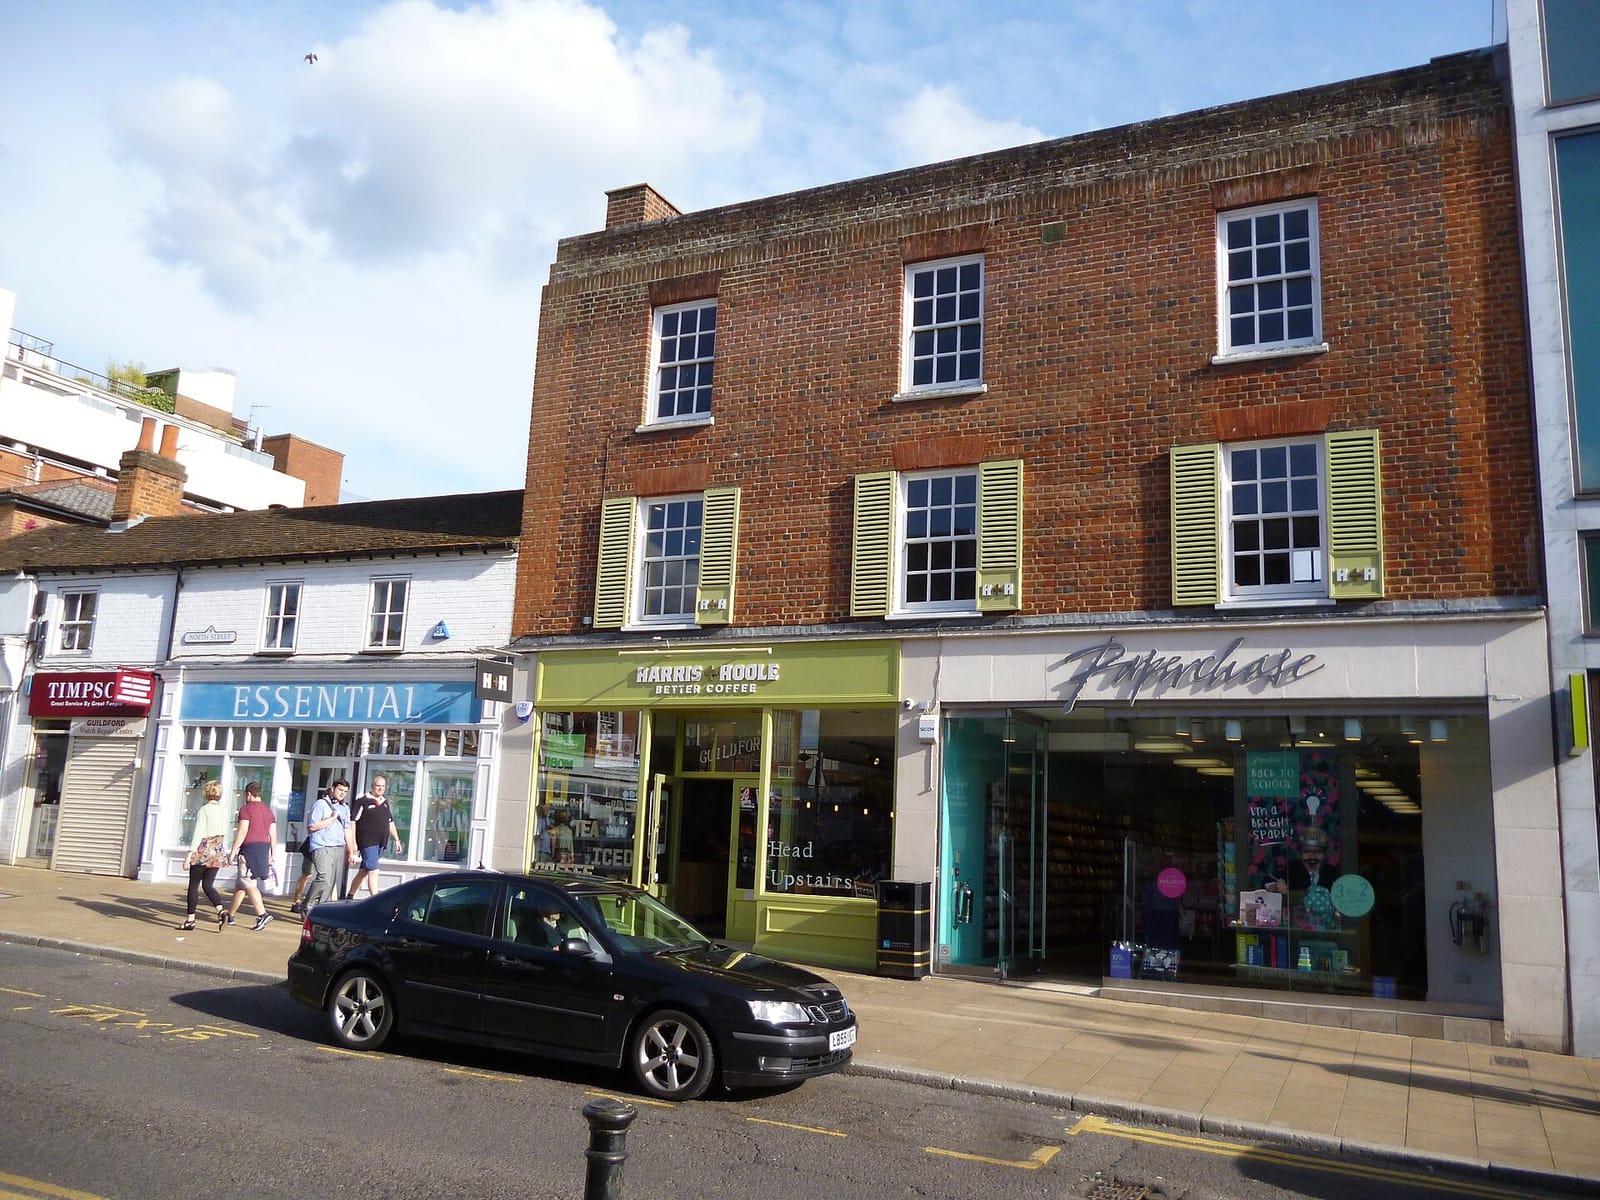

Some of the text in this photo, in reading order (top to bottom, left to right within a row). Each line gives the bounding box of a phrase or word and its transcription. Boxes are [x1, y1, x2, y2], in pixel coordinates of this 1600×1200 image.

[636, 665, 703, 683] HARRIS
[719, 663, 780, 681] HOOLE
[1063, 636, 1326, 715] Paperchase
[48, 682, 115, 699] TIMPSO
[655, 683, 757, 694] BETTER COFFEE
[233, 685, 423, 719] ESSENTIAL
[700, 736, 761, 763] GUILDFOR
[1280, 768, 1295, 778] TO
[574, 820, 599, 837] TEA
[591, 847, 633, 867] ICED
[768, 841, 814, 858] Head
[770, 869, 853, 891] Upstairs
[1360, 882, 1368, 896] 2
